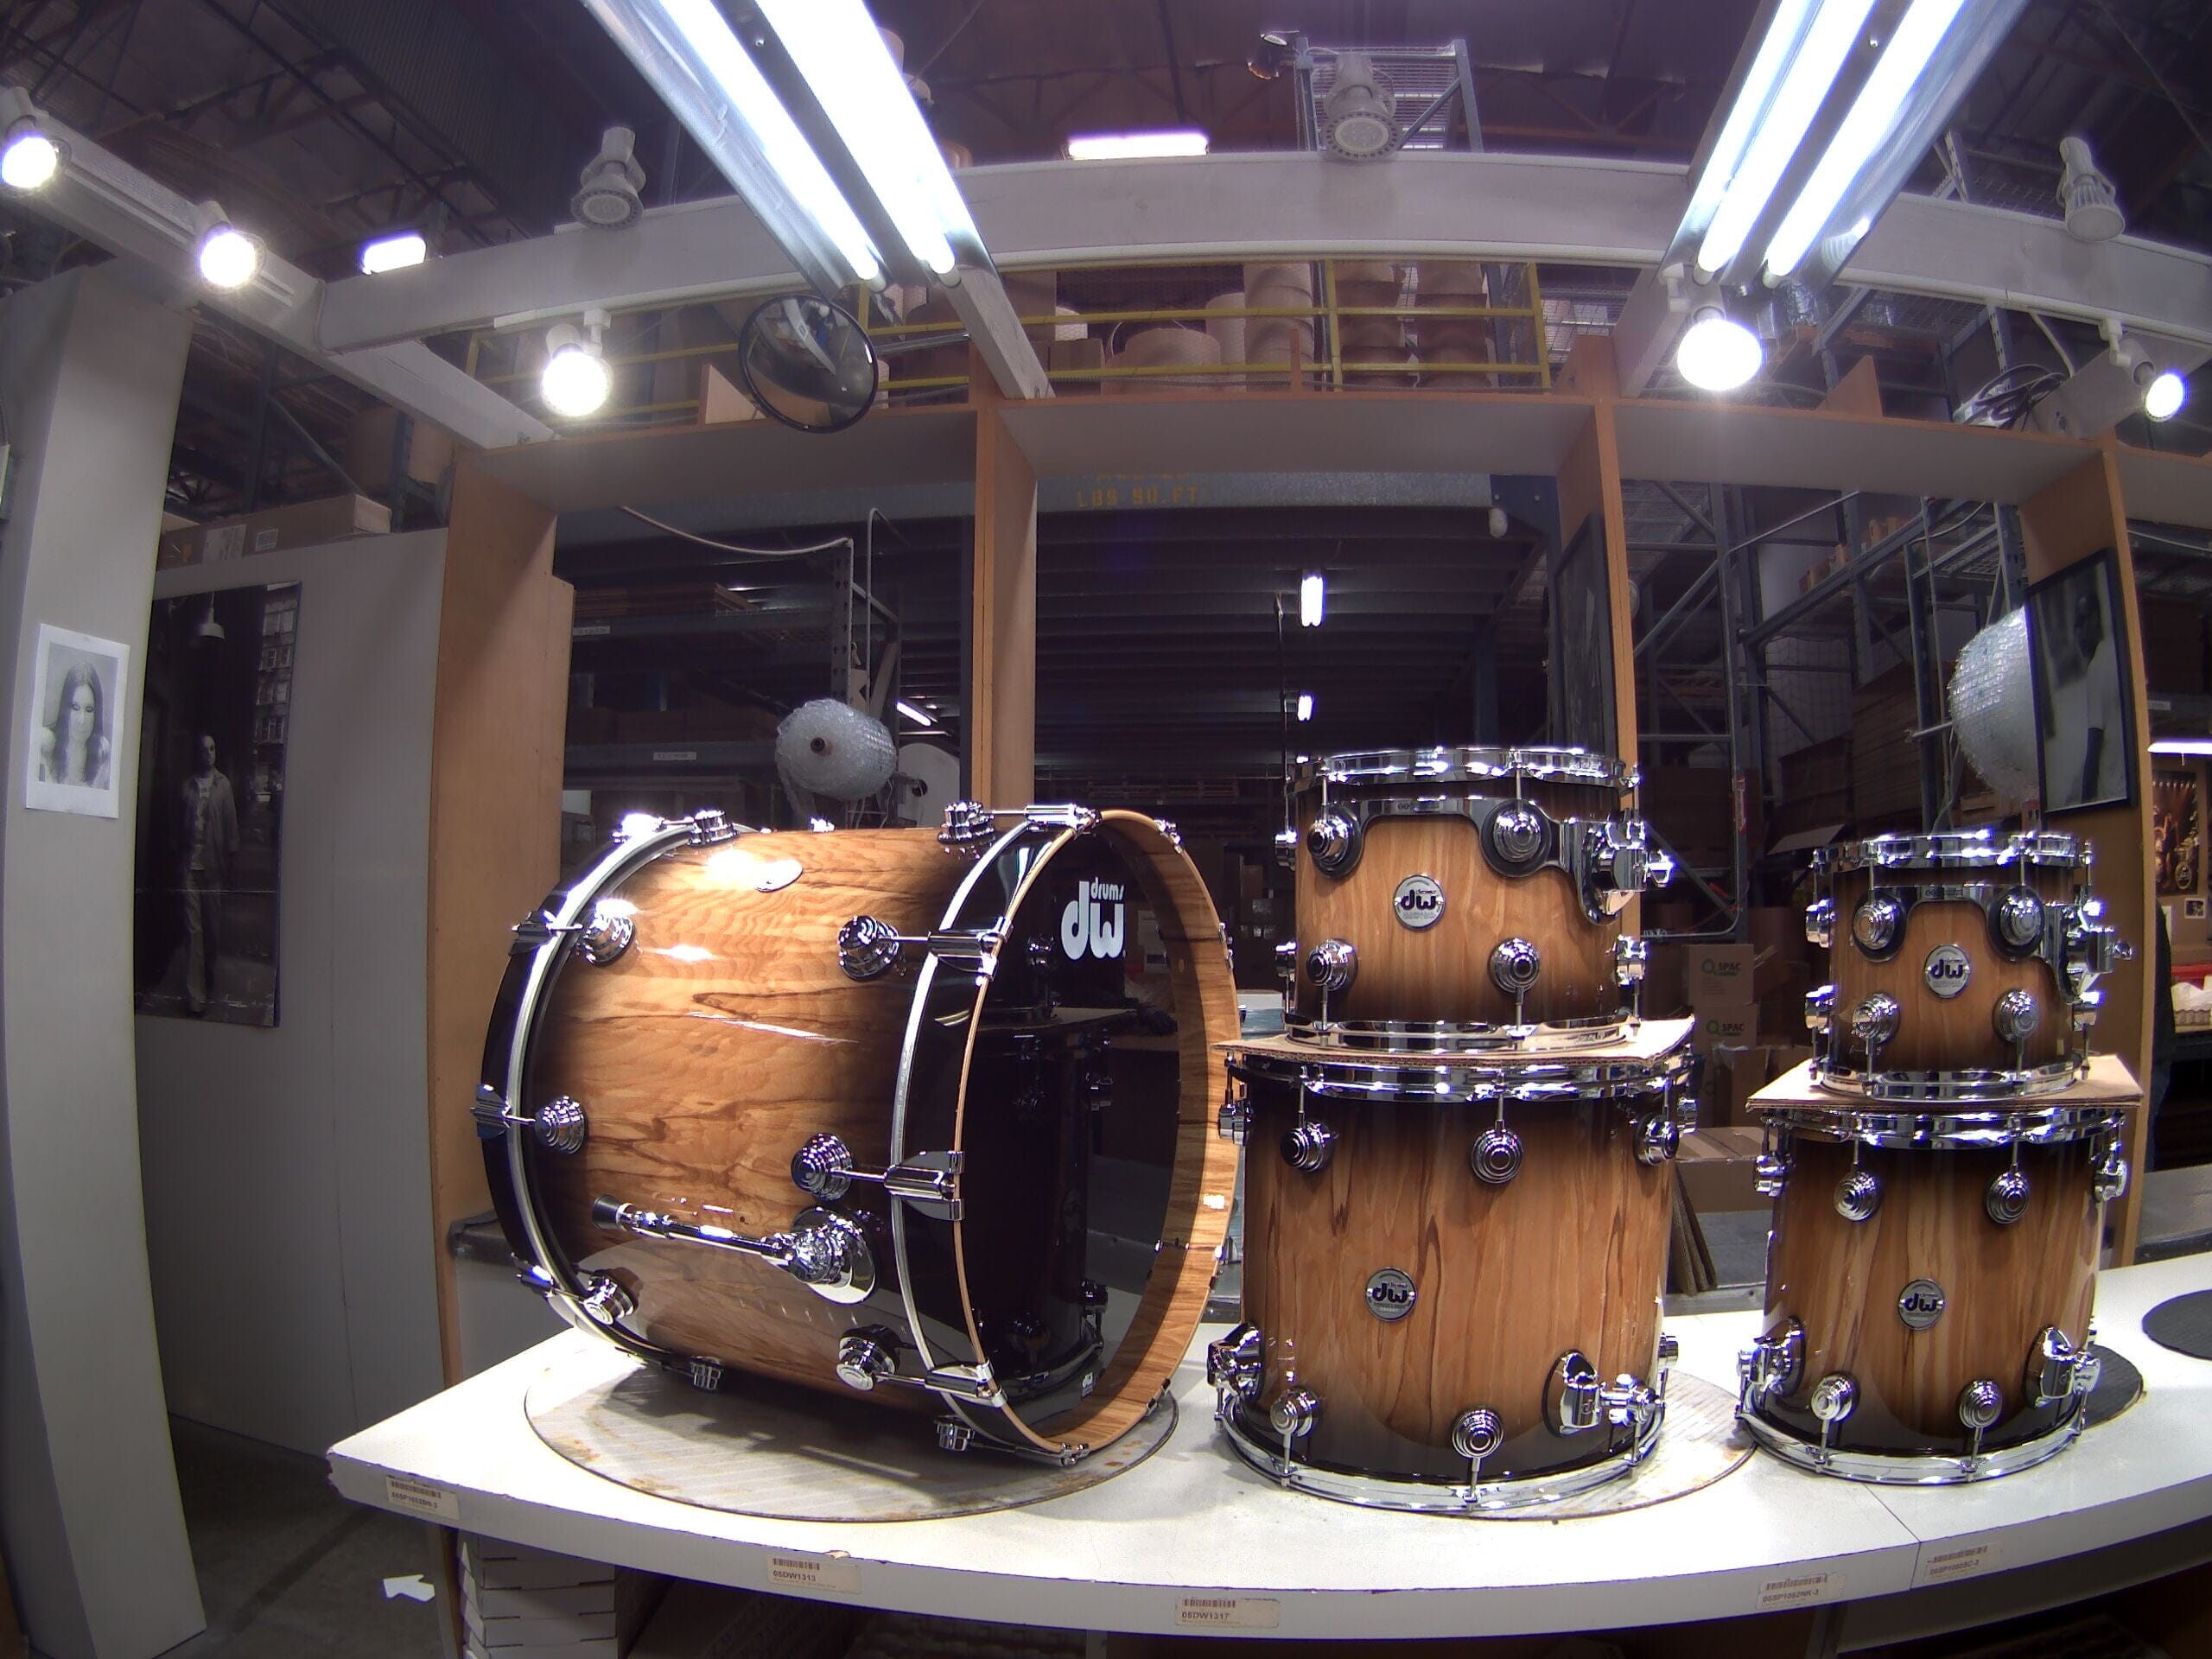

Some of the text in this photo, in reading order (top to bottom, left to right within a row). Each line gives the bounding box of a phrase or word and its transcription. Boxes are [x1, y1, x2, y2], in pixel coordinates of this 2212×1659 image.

[1090, 877, 1124, 900] drums
[1401, 889, 1436, 911] dw
[1061, 880, 1124, 960] dw
[1930, 959, 1963, 979] dw
[1372, 1282, 1408, 1303] dw
[1904, 1293, 1937, 1312] dw
